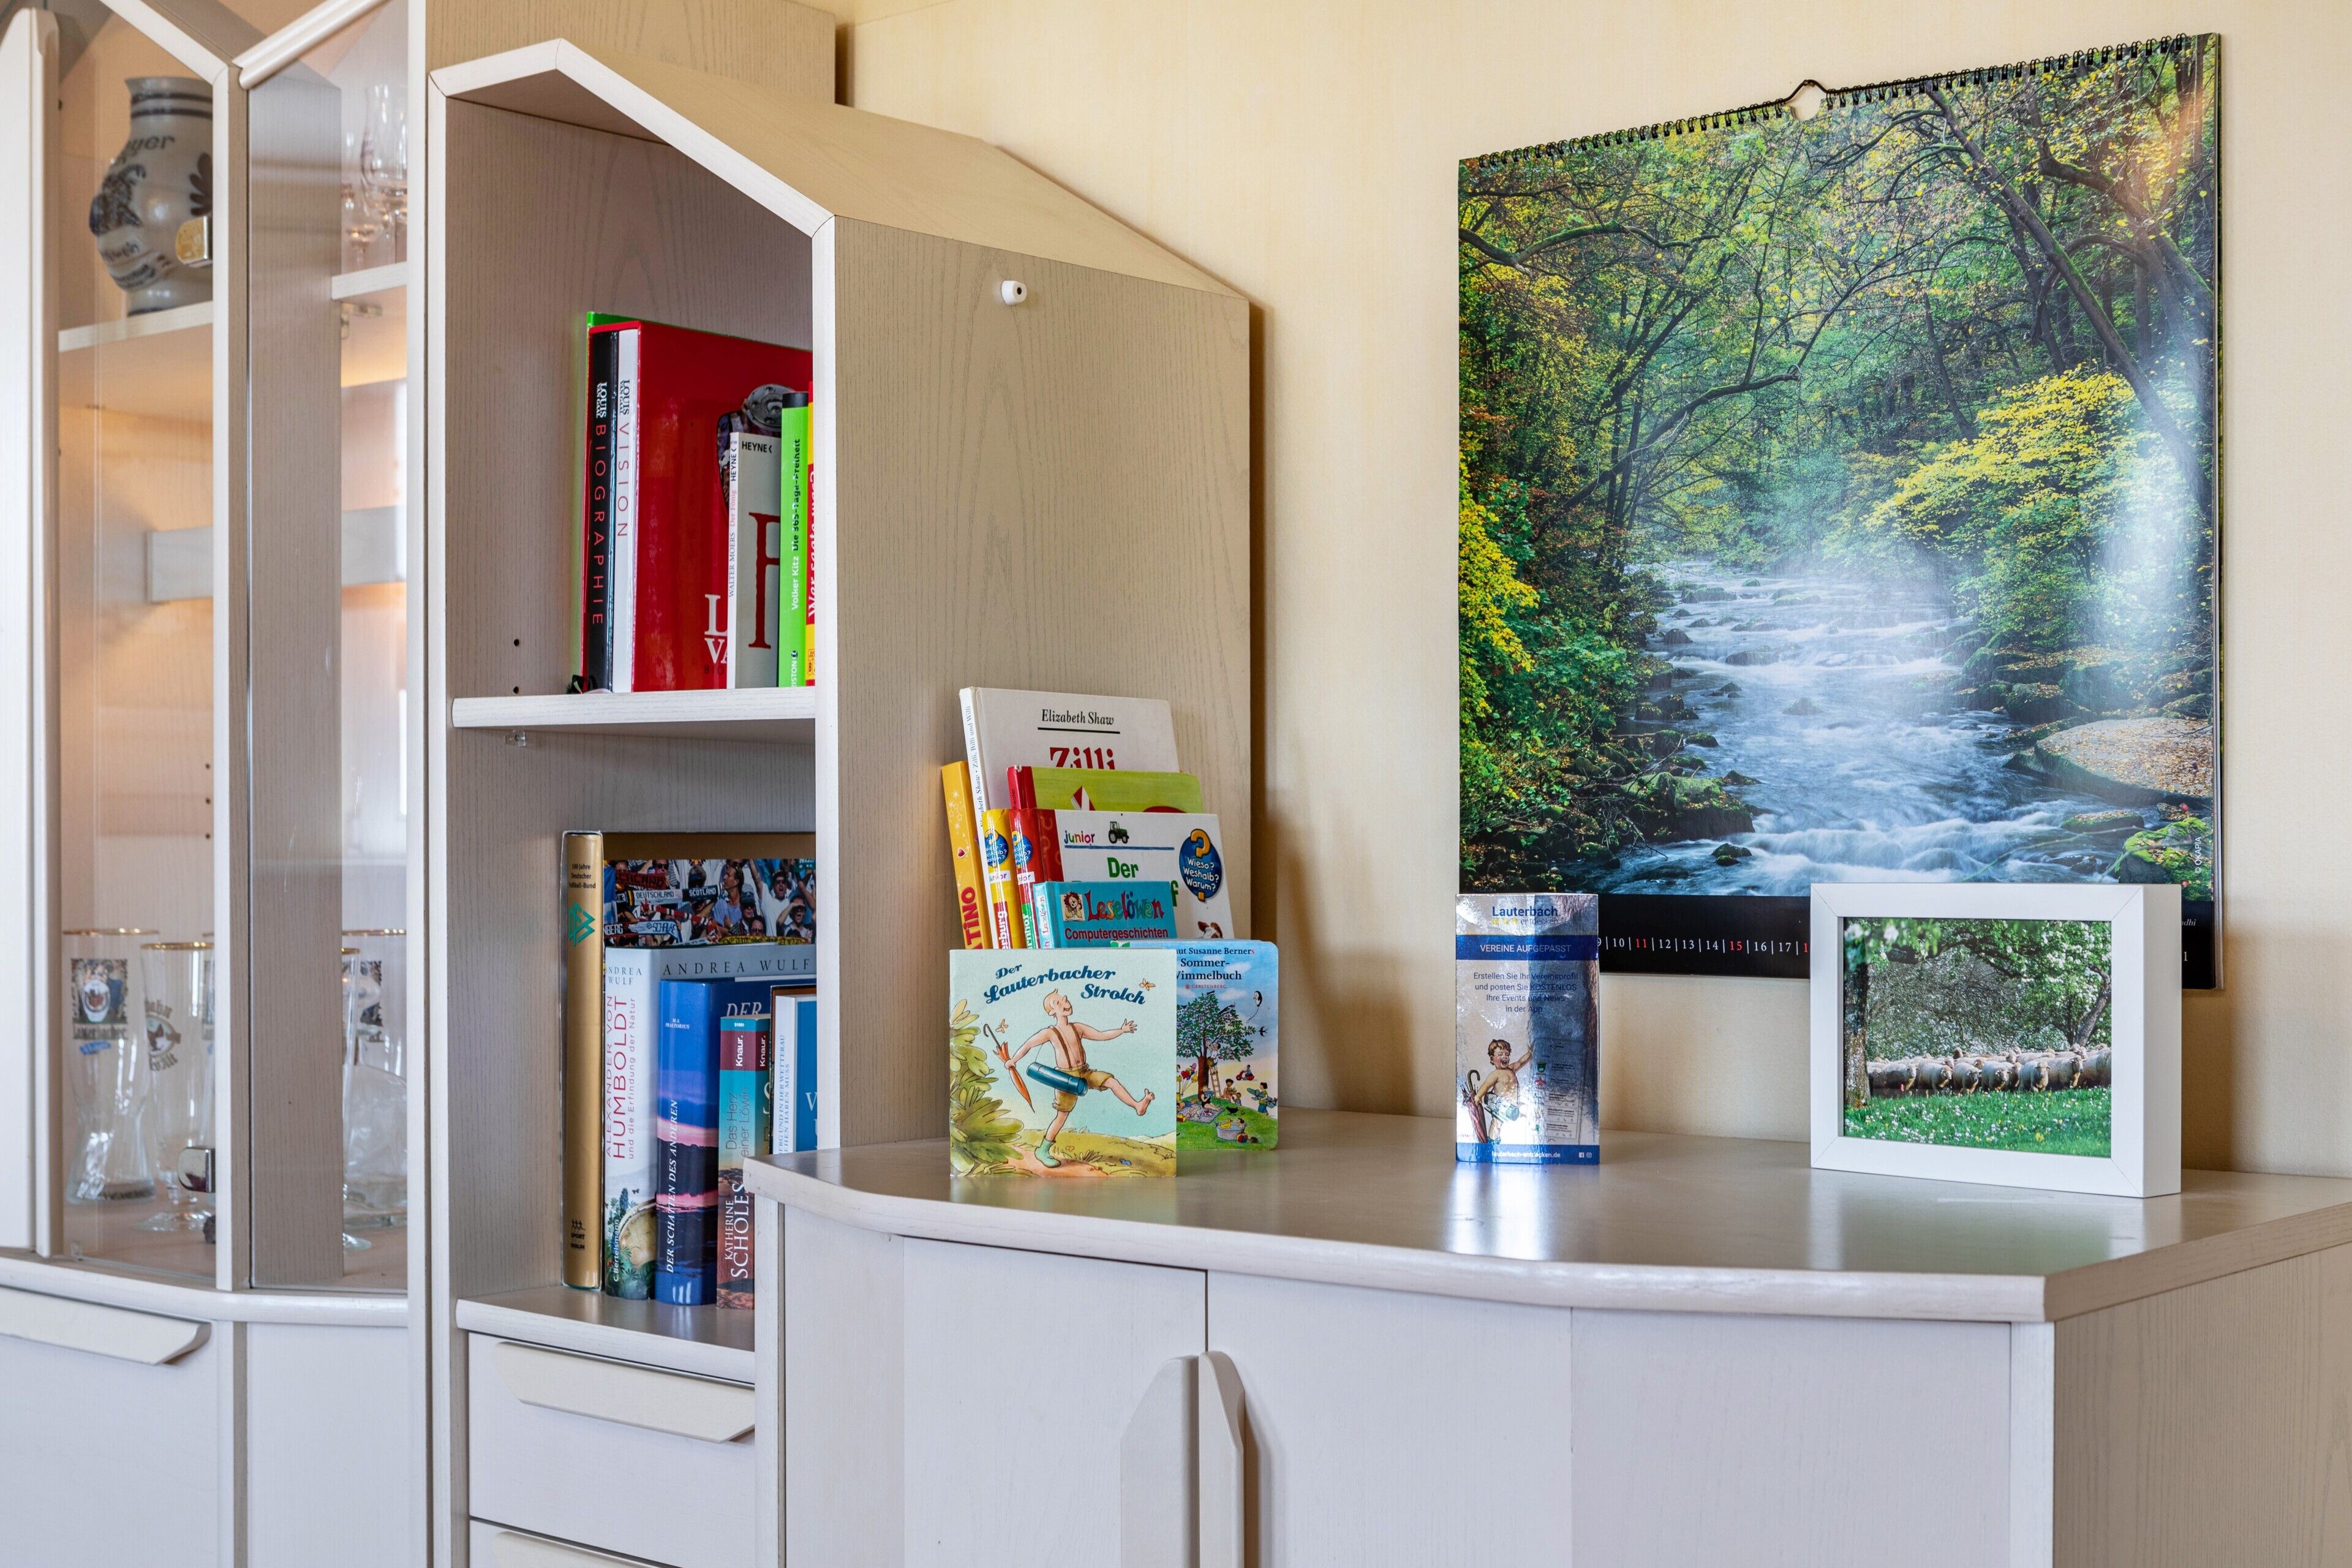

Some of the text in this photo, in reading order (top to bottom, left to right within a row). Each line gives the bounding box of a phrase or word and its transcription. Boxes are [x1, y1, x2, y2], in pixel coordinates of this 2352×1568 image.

[742, 441, 767, 453] HEYNE
[617, 423, 630, 536] VISION
[792, 439, 801, 532] 365-Tage-Freiheit
[592, 424, 606, 624] BIOGRAPHIE
[1041, 708, 1114, 725] Elizabeth Shaw
[1064, 829, 1095, 845] junior
[1107, 857, 1139, 878] Der
[1187, 857, 1215, 870] Wieso?
[1183, 866, 1219, 883] Weshalb?
[1186, 876, 1216, 892] Warum?
[636, 891, 674, 899] DEUTSCHLAND
[689, 888, 717, 897] SCOTLAND
[1085, 889, 1165, 921] Leselöwen
[1492, 906, 1558, 916] Lauterbach
[1064, 927, 1169, 942] Computergeschichten
[1613, 938, 1624, 948] 10
[1635, 938, 1648, 949] 11
[1659, 939, 1672, 949] 12
[1683, 940, 1695, 950] 13
[1706, 940, 1719, 951] 14
[1730, 941, 1743, 951] 15
[1755, 941, 1767, 952] 16
[1779, 942, 1791, 952] 17
[663, 959, 810, 975] ANDREA WULF
[995, 963, 1022, 979] Der
[1180, 958, 1231, 968] Sommer-
[608, 976, 633, 985] WULF
[984, 965, 1116, 1004] Lauterbacher
[1532, 972, 1578, 981] Vereinsprofil
[1080, 983, 1145, 1005] Strolch
[1528, 1006, 1543, 1014] App
[612, 996, 627, 1158] HUMBOLDT
[726, 1093, 738, 1150] Das Herz
[739, 1087, 750, 1158] einer Löwin
[668, 1159, 677, 1182] DES
[725, 1200, 734, 1260] KATHERINE
[731, 1183, 749, 1279] SCHOLES
